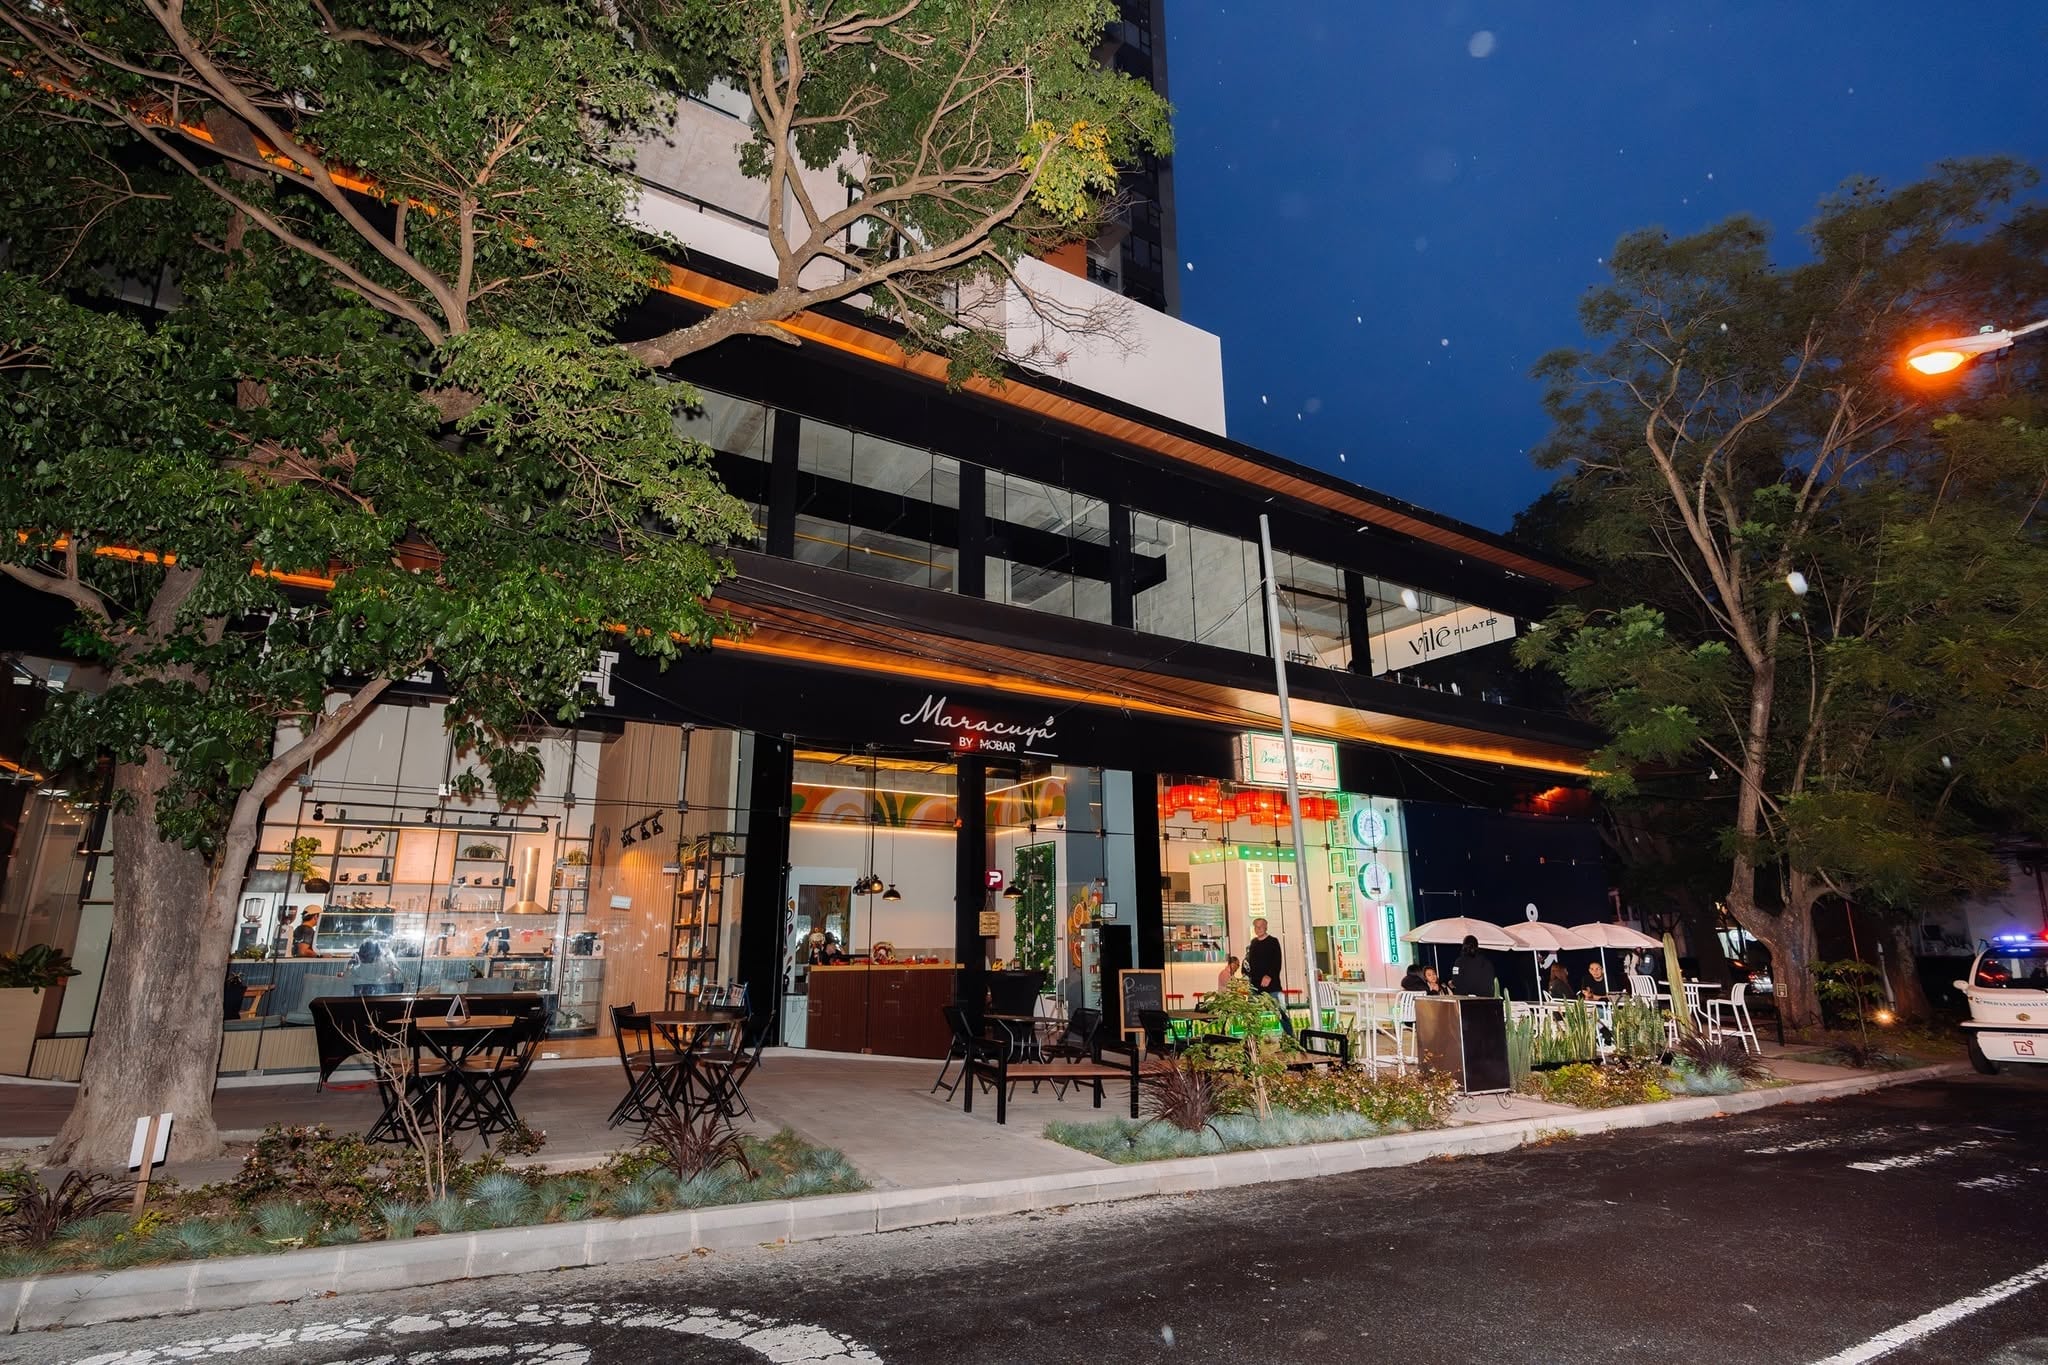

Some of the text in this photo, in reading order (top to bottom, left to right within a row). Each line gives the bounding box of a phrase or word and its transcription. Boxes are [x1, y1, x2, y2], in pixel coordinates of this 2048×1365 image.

[1454, 617, 1498, 636] PILATES
[900, 694, 1057, 747] Maracuyá
[959, 736, 1016, 753] BY MOBAR
[1388, 907, 1398, 962] ABIERTO
